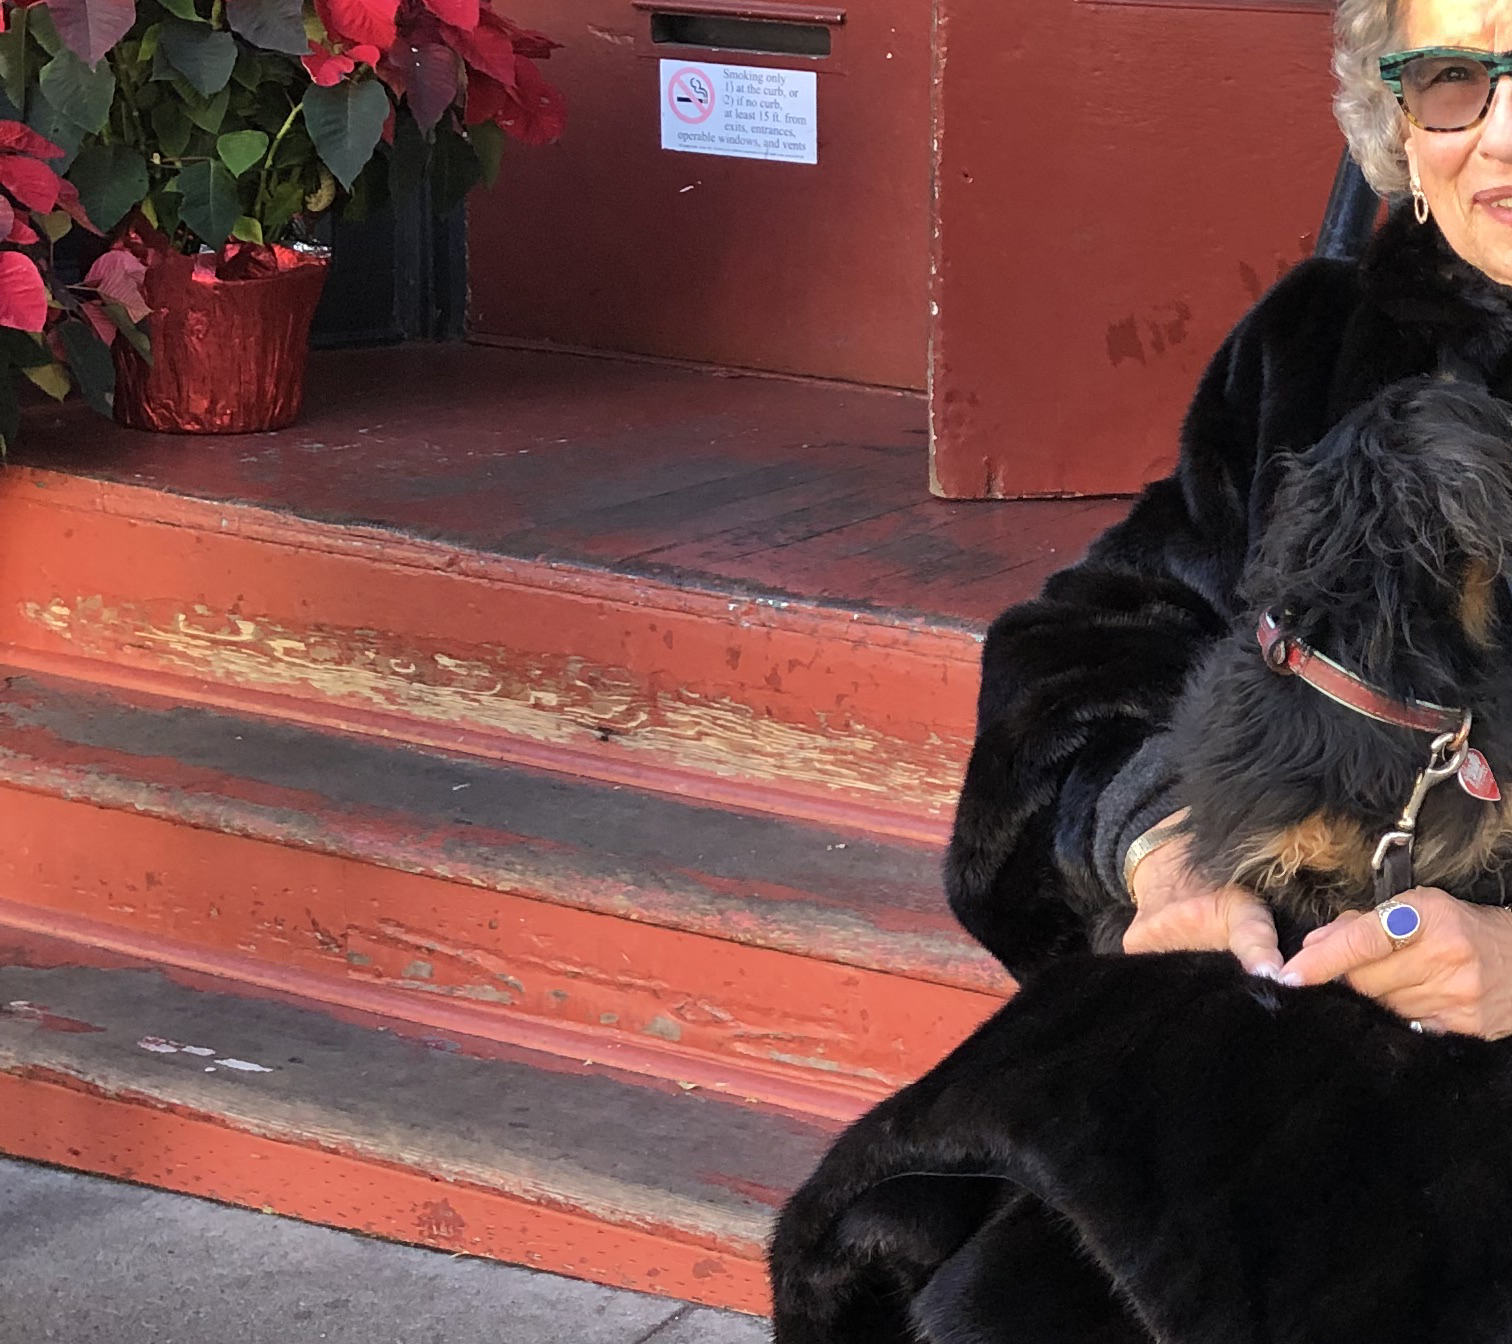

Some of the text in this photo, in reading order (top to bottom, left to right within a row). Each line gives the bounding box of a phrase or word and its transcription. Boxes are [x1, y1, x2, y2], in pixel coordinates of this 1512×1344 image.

[723, 68, 786, 86] Smoking only
[725, 81, 799, 98] 1) at the curb, or
[723, 94, 783, 110] 2) if no curb,
[724, 109, 732, 118] at
[735, 108, 756, 121] least
[760, 110, 769, 122] 15
[785, 113, 807, 125] from
[724, 121, 796, 138] exits, entrances,
[677, 131, 716, 143] operable
[718, 135, 761, 148] windows,
[763, 138, 780, 149] and
[782, 141, 806, 151] vents
